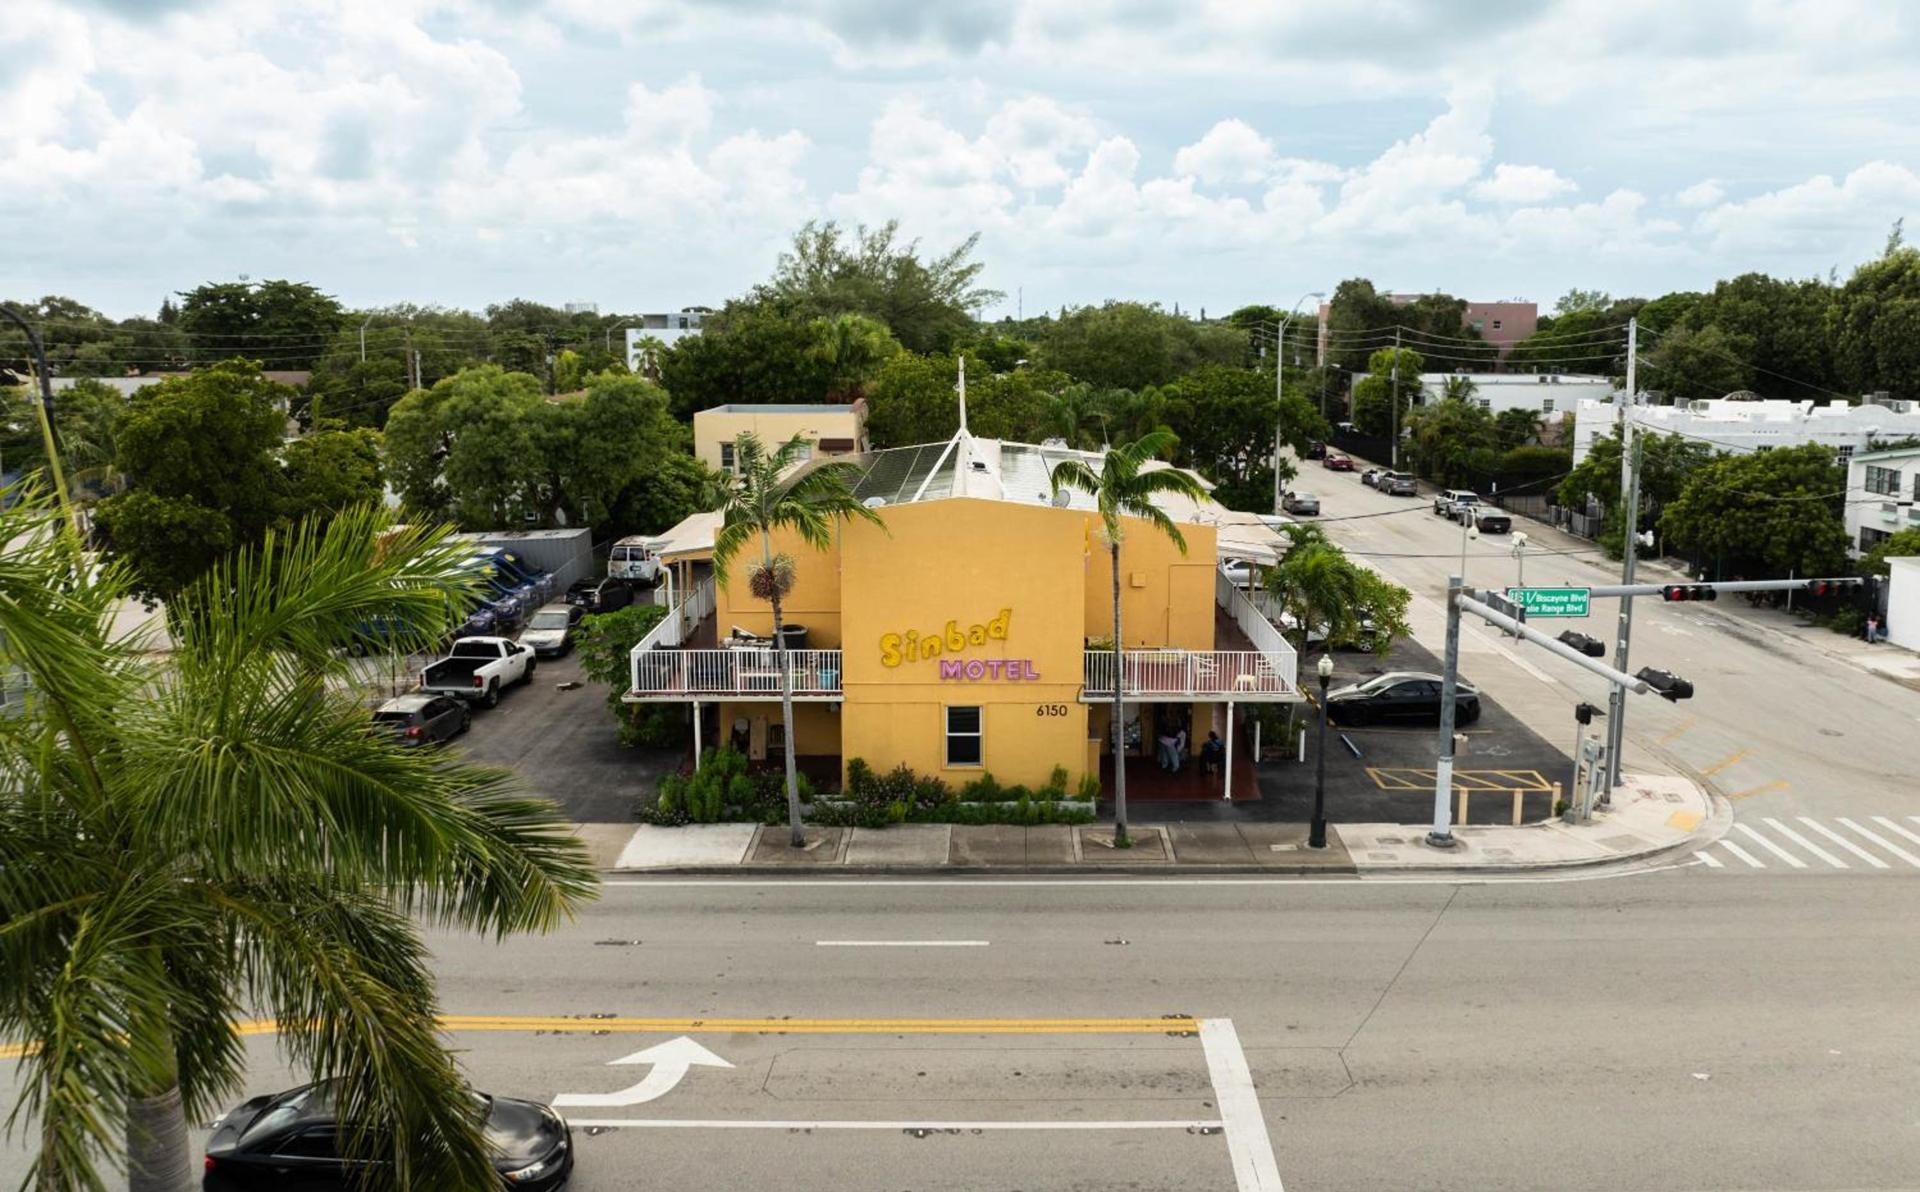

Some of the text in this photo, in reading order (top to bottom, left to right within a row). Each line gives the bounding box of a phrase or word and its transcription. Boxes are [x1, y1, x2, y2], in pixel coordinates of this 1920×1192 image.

[1571, 594, 1586, 602] Blvd
[1541, 604, 1564, 614] Range
[1566, 604, 1583, 613] Blvd
[880, 608, 1012, 668] Sinbad
[940, 660, 1040, 681] MOTEL
[1036, 704, 1068, 717] 6150
